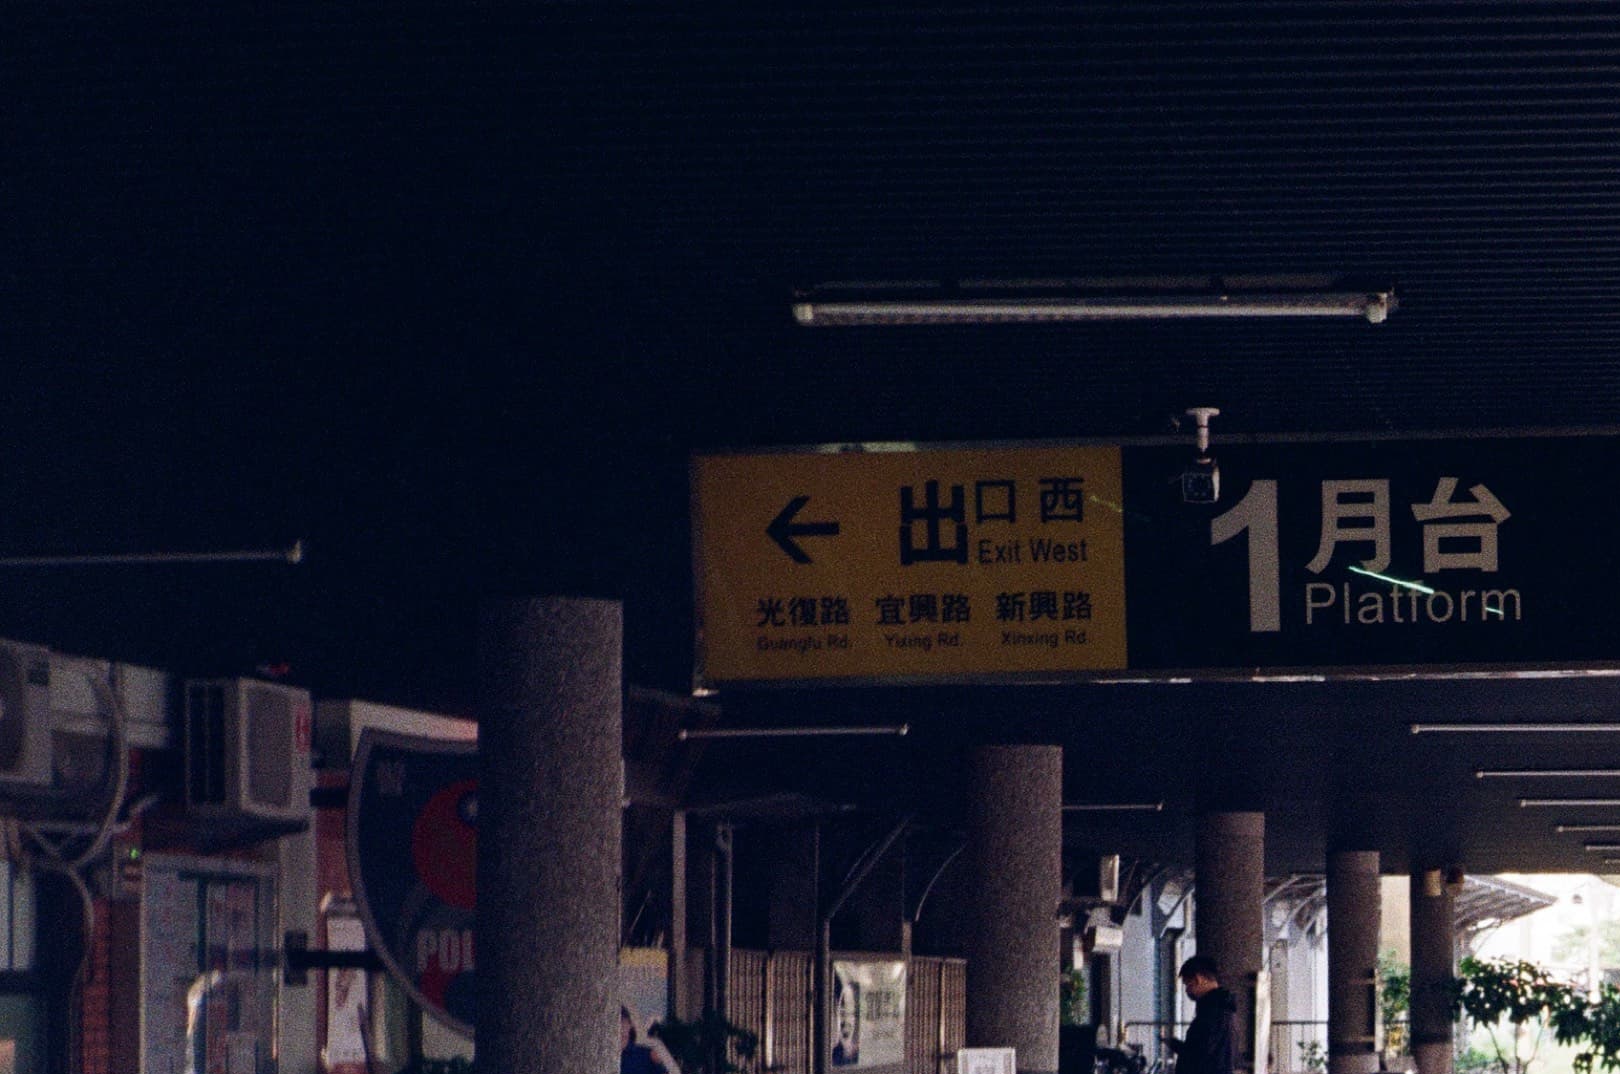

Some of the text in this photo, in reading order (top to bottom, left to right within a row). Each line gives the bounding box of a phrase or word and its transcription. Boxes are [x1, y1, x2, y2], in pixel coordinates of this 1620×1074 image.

[978, 538, 1089, 564] Exit West
[756, 597, 850, 627] 光復路
[875, 594, 973, 625] 宜興路
[995, 591, 1093, 622] 新興路
[1304, 581, 1522, 625] Platform
[883, 634, 932, 651] Yixing
[1000, 630, 1061, 648] Xinxing
